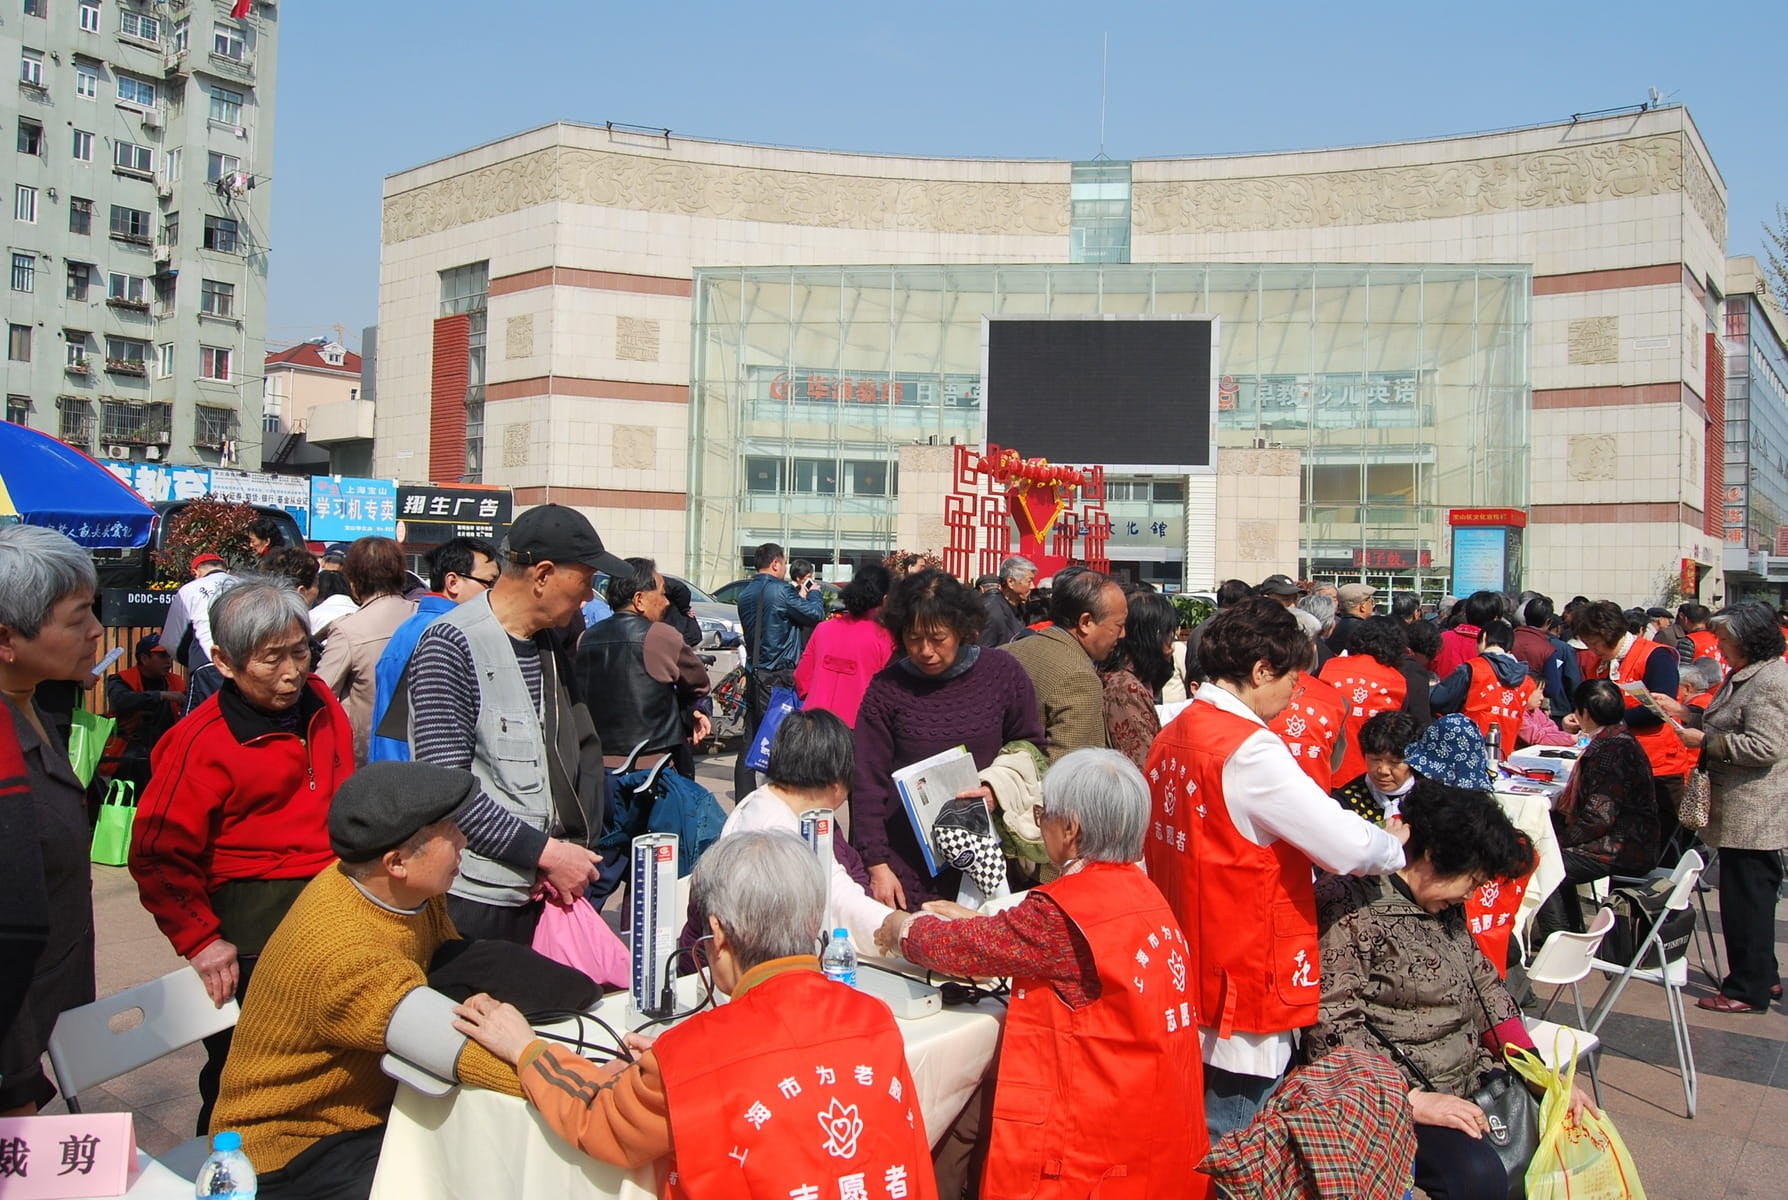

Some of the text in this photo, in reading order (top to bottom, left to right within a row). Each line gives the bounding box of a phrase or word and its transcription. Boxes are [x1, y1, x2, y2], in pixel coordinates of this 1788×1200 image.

[346, 485, 388, 496] 上海宝山
[315, 496, 395, 522] 学习机专卖
[403, 495, 500, 518] 翔生广告
[1165, 1002, 1198, 1033] 志愿
